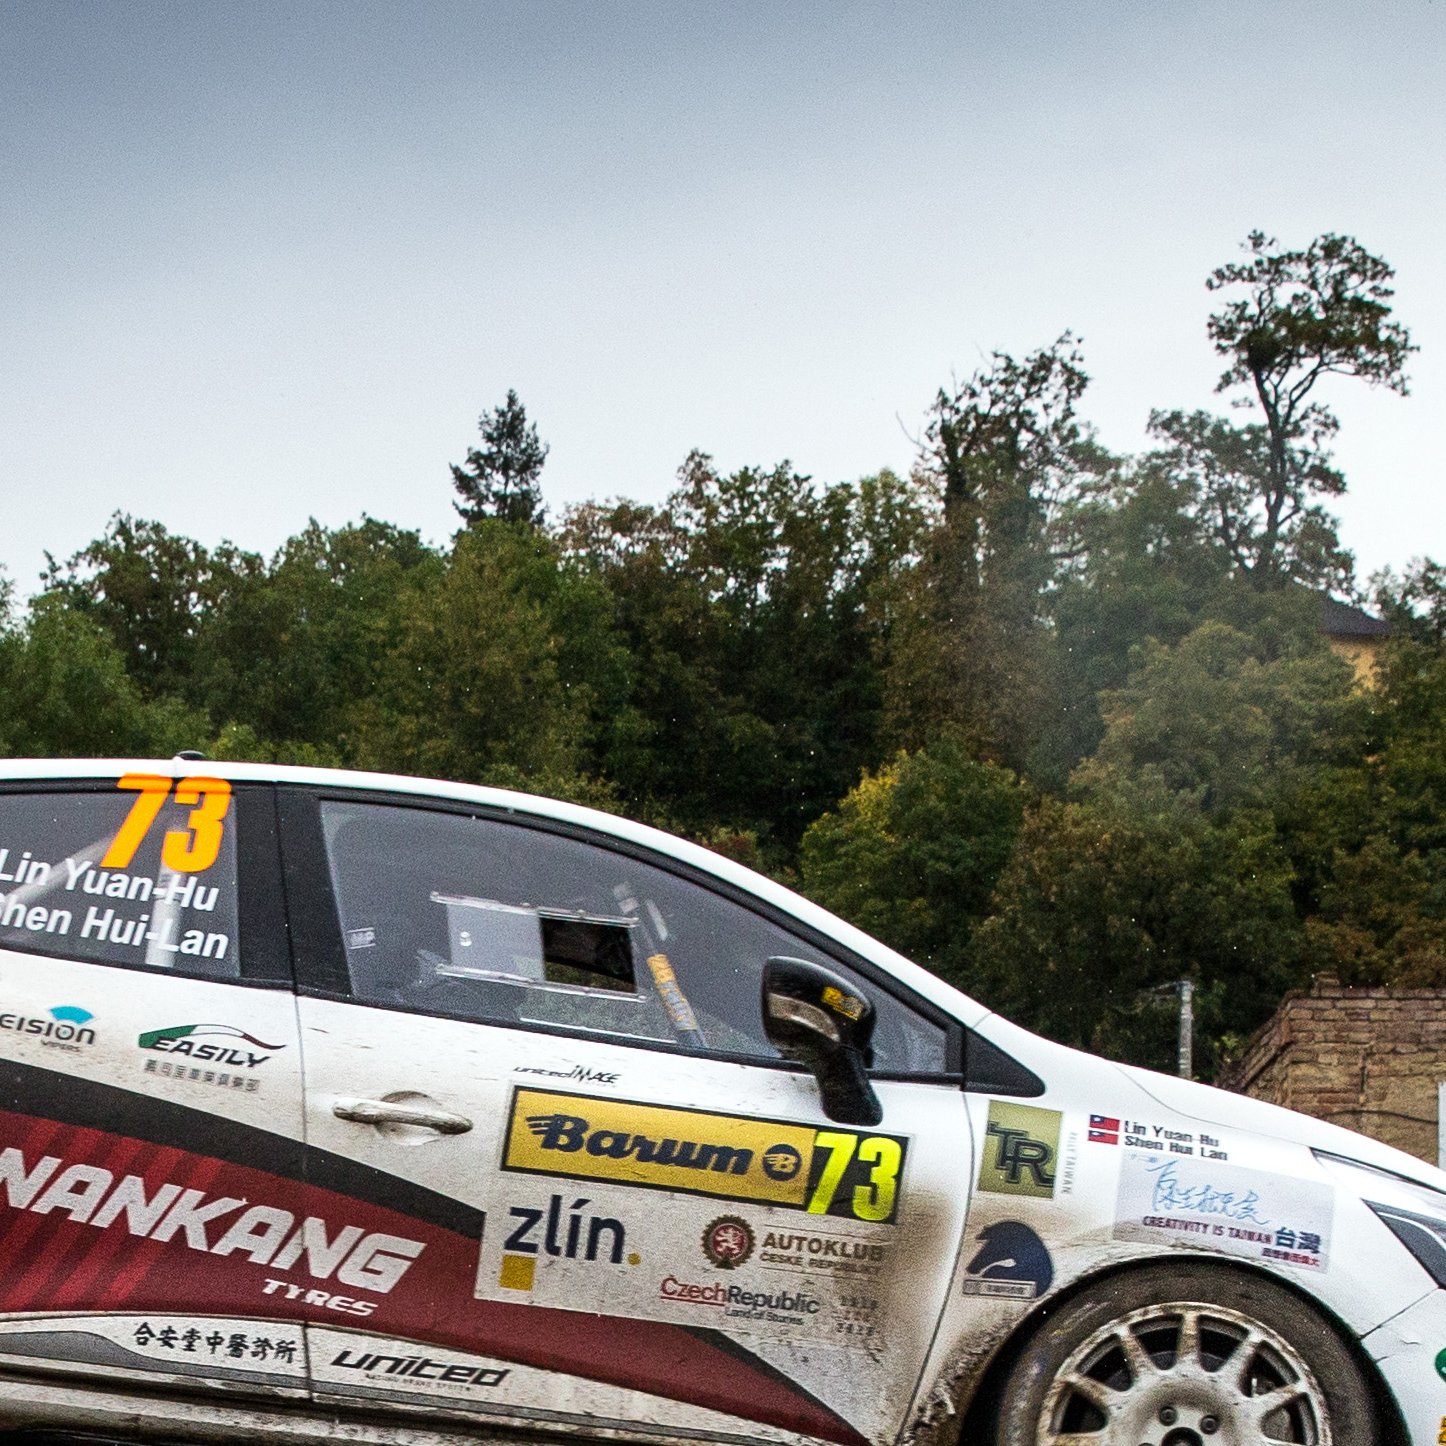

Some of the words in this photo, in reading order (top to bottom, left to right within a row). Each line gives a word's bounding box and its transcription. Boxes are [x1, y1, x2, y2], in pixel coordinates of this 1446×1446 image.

[100, 773, 231, 872] 73
[65, 858, 219, 911] Yuan-Hu
[81, 906, 229, 959] Hui-Lan
[153, 1036, 270, 1068] EASILY
[525, 1114, 753, 1175] Barum
[1124, 1120, 1146, 1135] Lin
[806, 1133, 901, 1222] 73
[1142, 1215, 1209, 1235] CREATIVITY
[1213, 1225, 1224, 1236] IS
[762, 1232, 883, 1262] AUTOKLUB
[261, 1278, 379, 1317] TYRES
[331, 1350, 510, 1387] united
